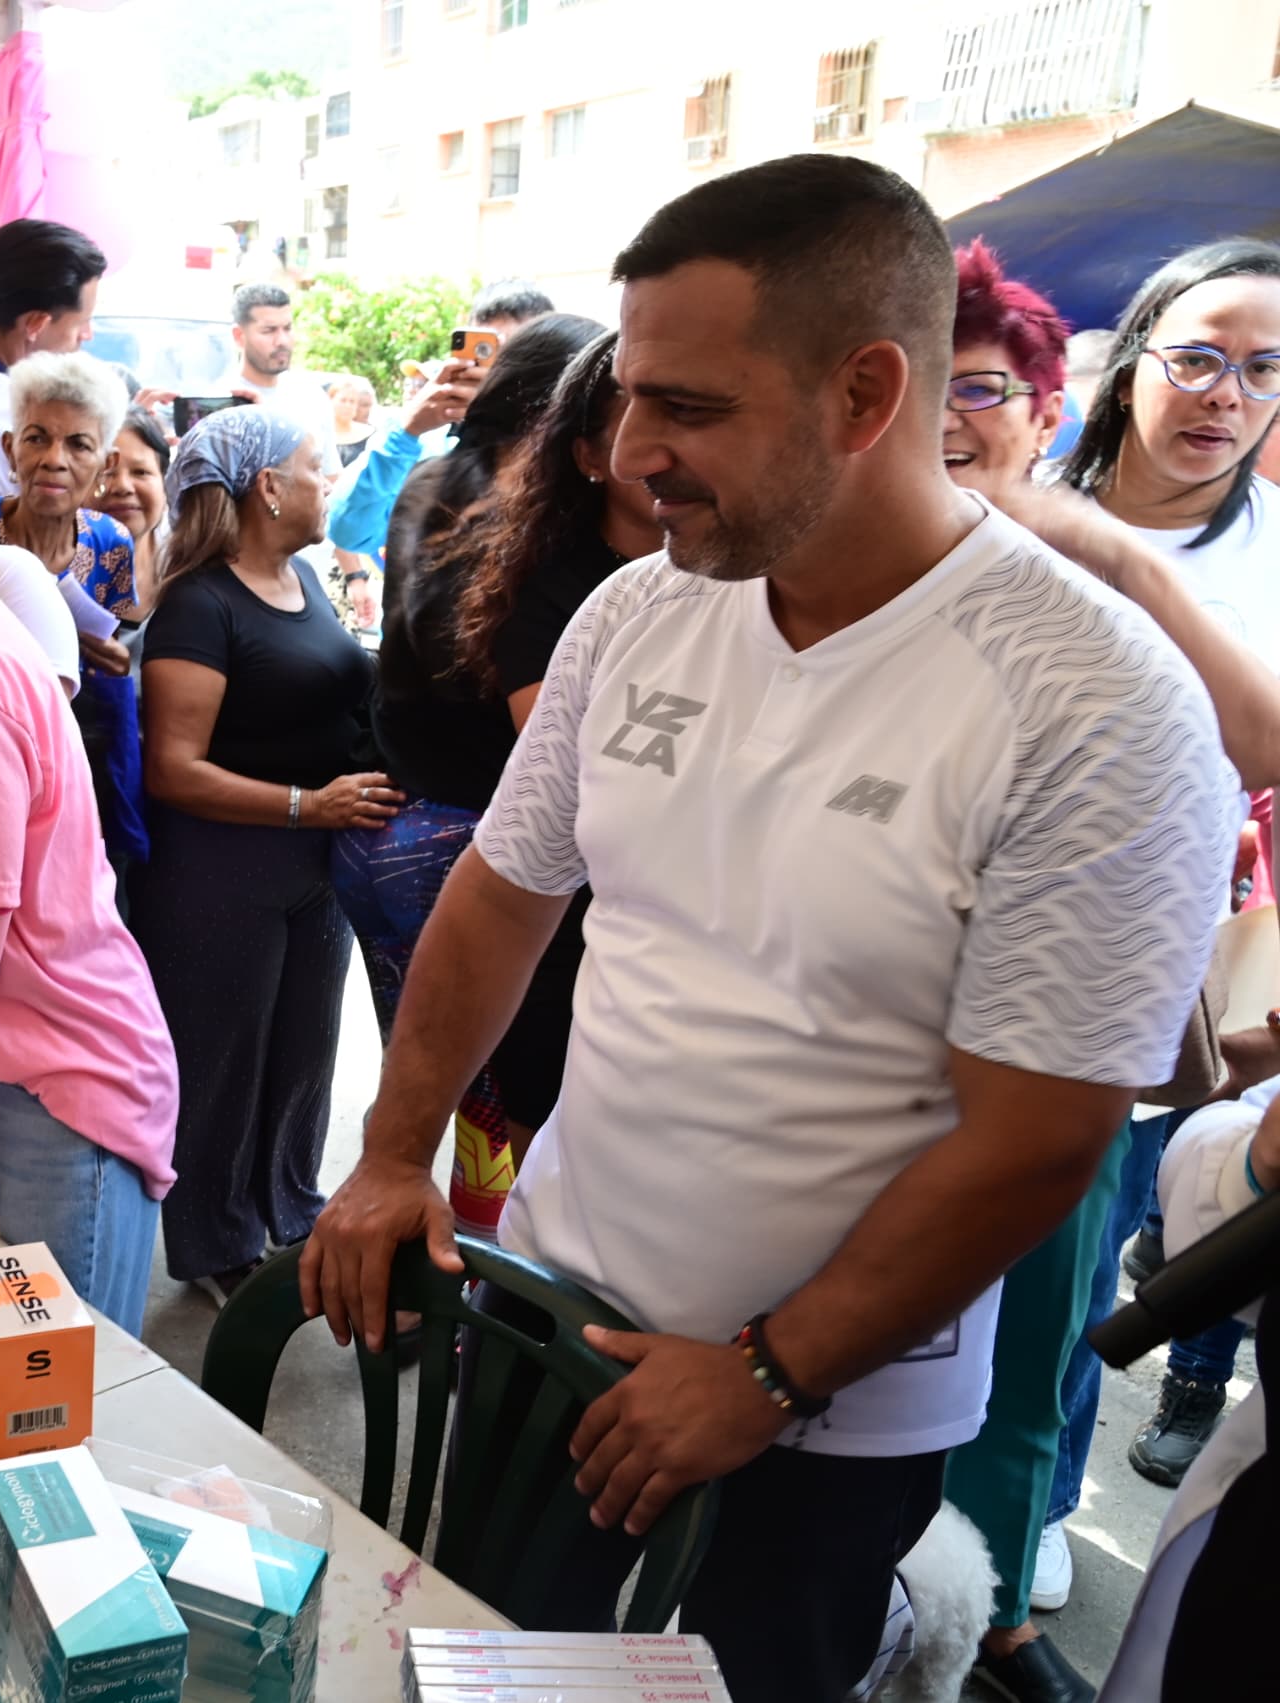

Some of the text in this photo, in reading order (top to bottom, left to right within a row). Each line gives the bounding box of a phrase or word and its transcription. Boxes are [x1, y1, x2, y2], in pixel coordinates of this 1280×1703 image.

[26, 1350, 52, 1371] S
[5, 1471, 46, 1544] Ciclogynon
[72, 1654, 132, 1672] Ciclogynon
[68, 1679, 127, 1697] Ciclogynon
